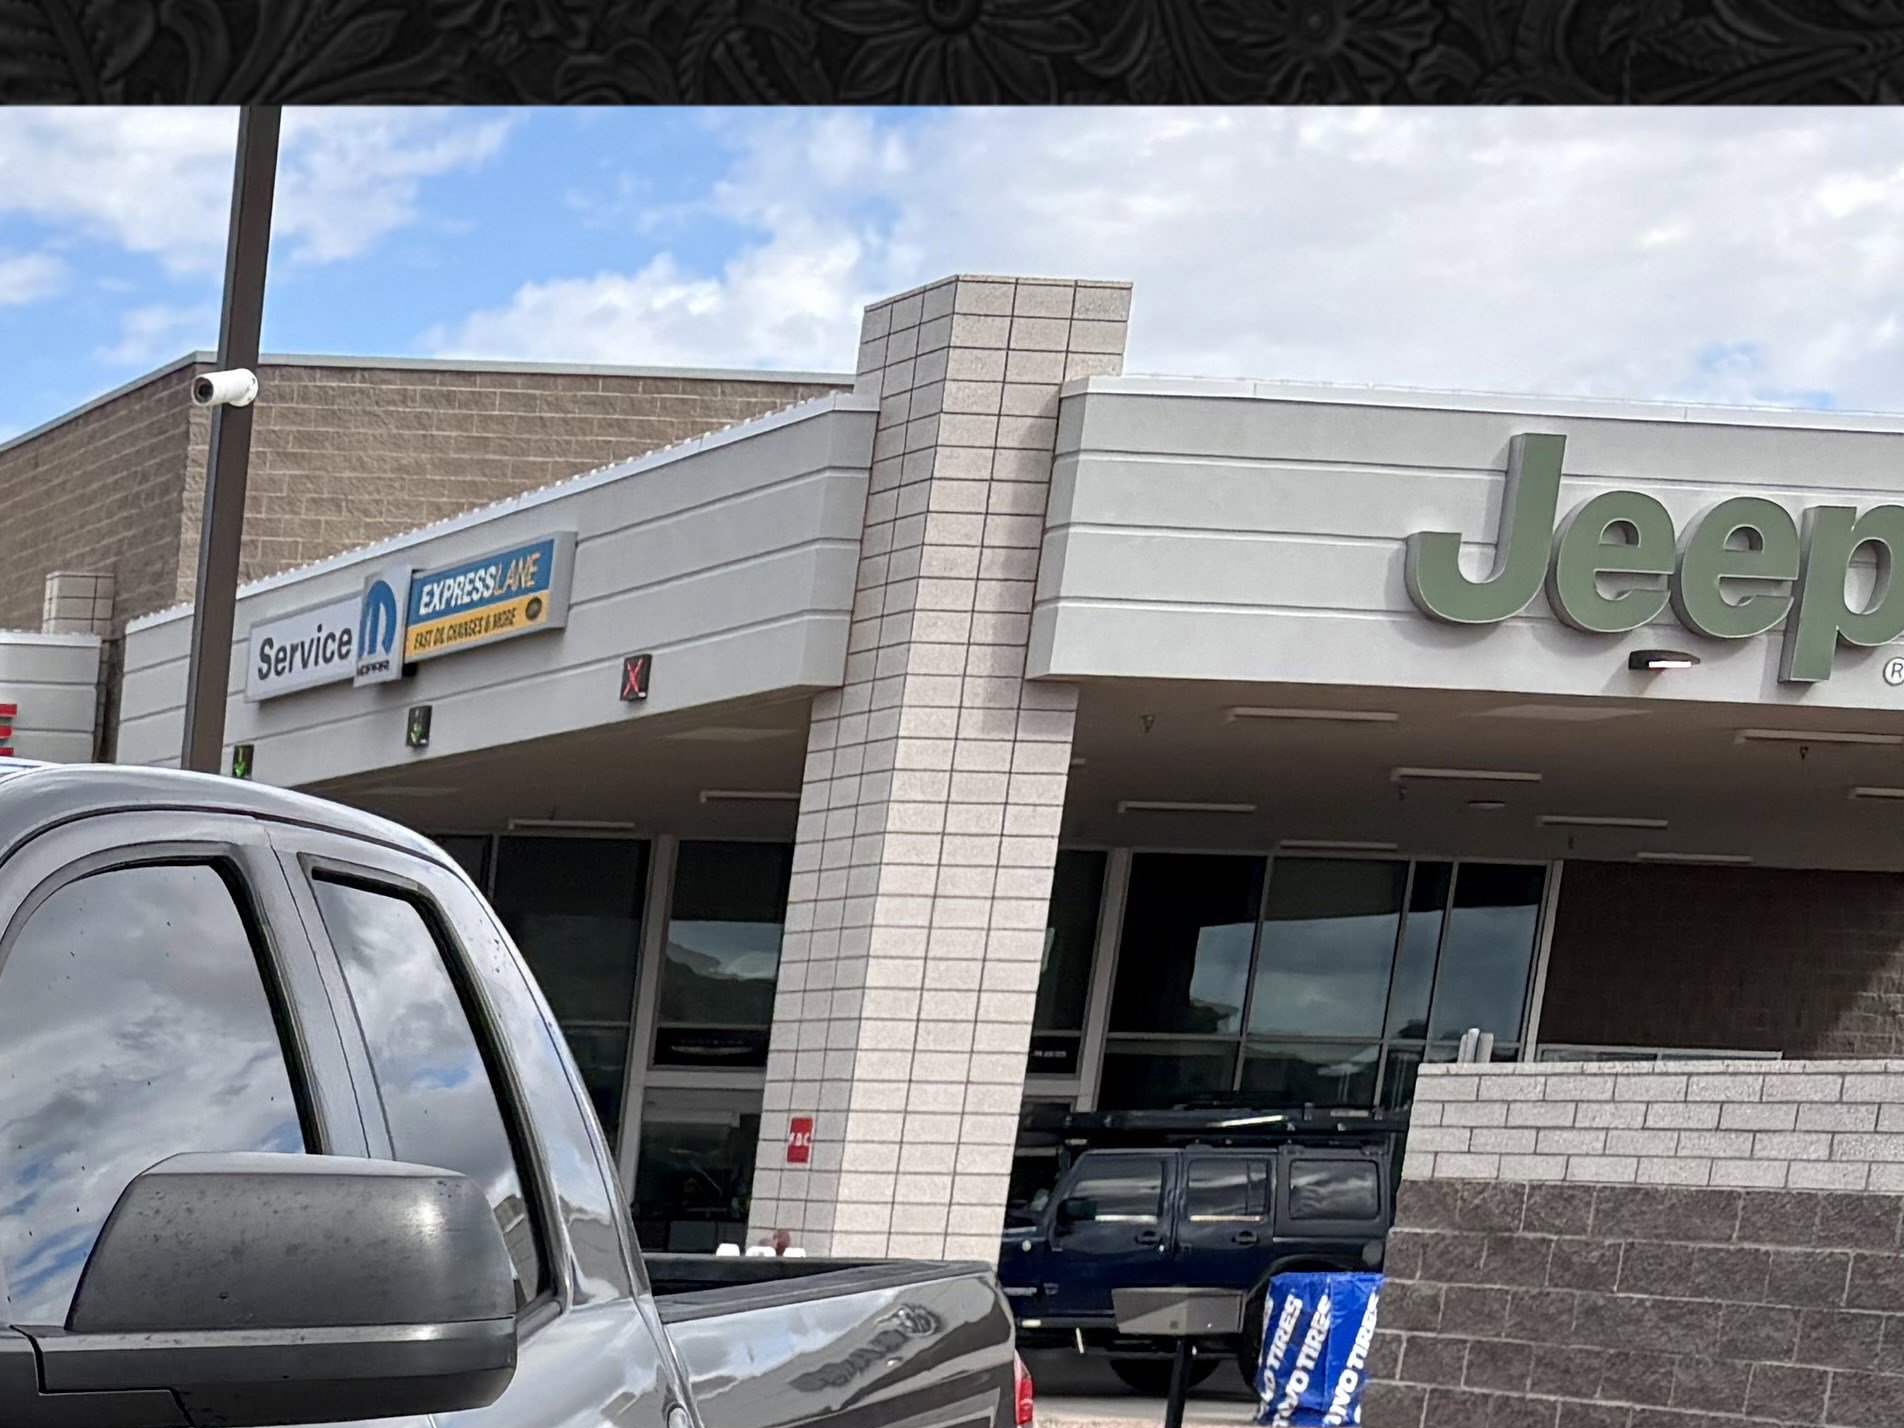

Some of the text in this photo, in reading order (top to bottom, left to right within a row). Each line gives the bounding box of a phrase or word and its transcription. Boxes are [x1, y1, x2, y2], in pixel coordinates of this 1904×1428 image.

[1405, 432, 1904, 683] Jeep
[258, 624, 352, 681] Service
[1266, 1293, 1303, 1371] TIRES
